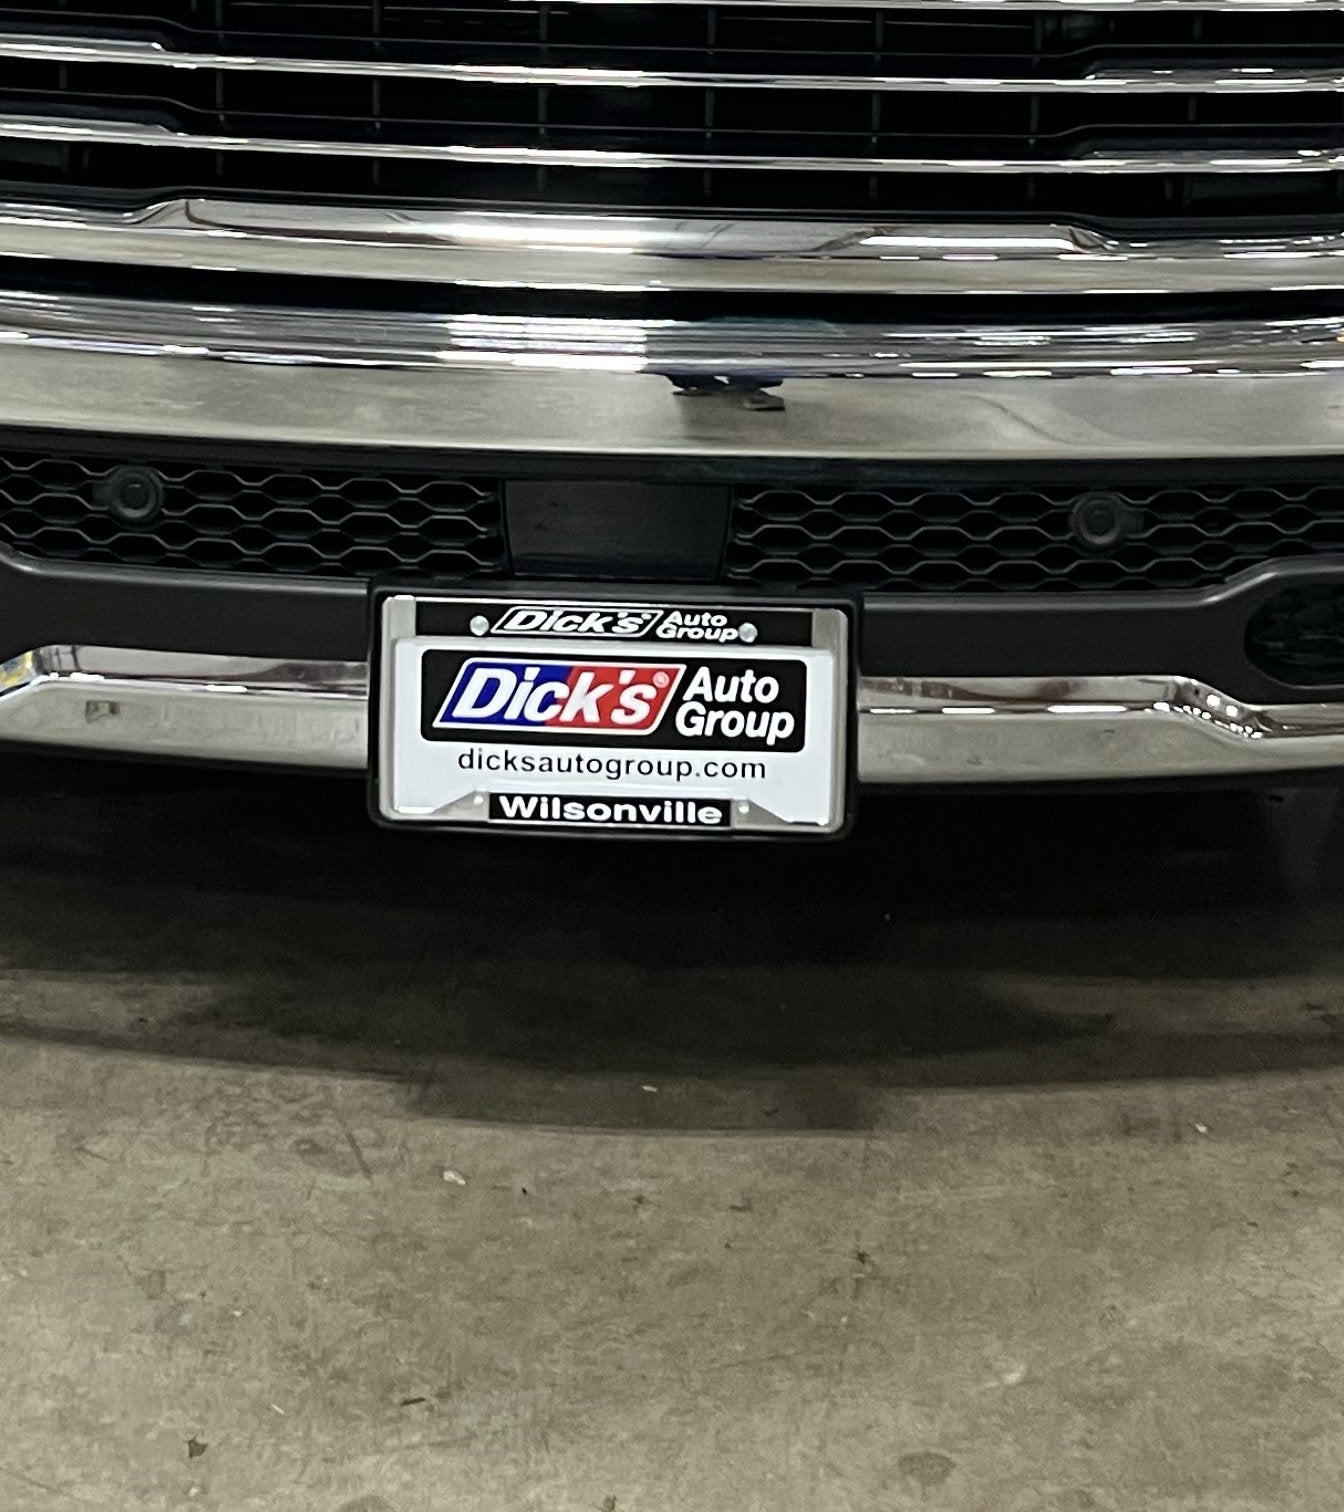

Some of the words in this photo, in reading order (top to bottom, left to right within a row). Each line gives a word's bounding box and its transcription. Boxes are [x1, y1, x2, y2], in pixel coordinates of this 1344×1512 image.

[504, 609, 645, 635] Dick's
[656, 624, 739, 643] Group
[662, 610, 728, 627] Auto
[452, 666, 657, 725] Dick's
[682, 666, 779, 704] Auto
[675, 701, 796, 746] Group
[457, 748, 766, 782] dicksautogroup.com
[499, 794, 723, 824] Wilsonville
